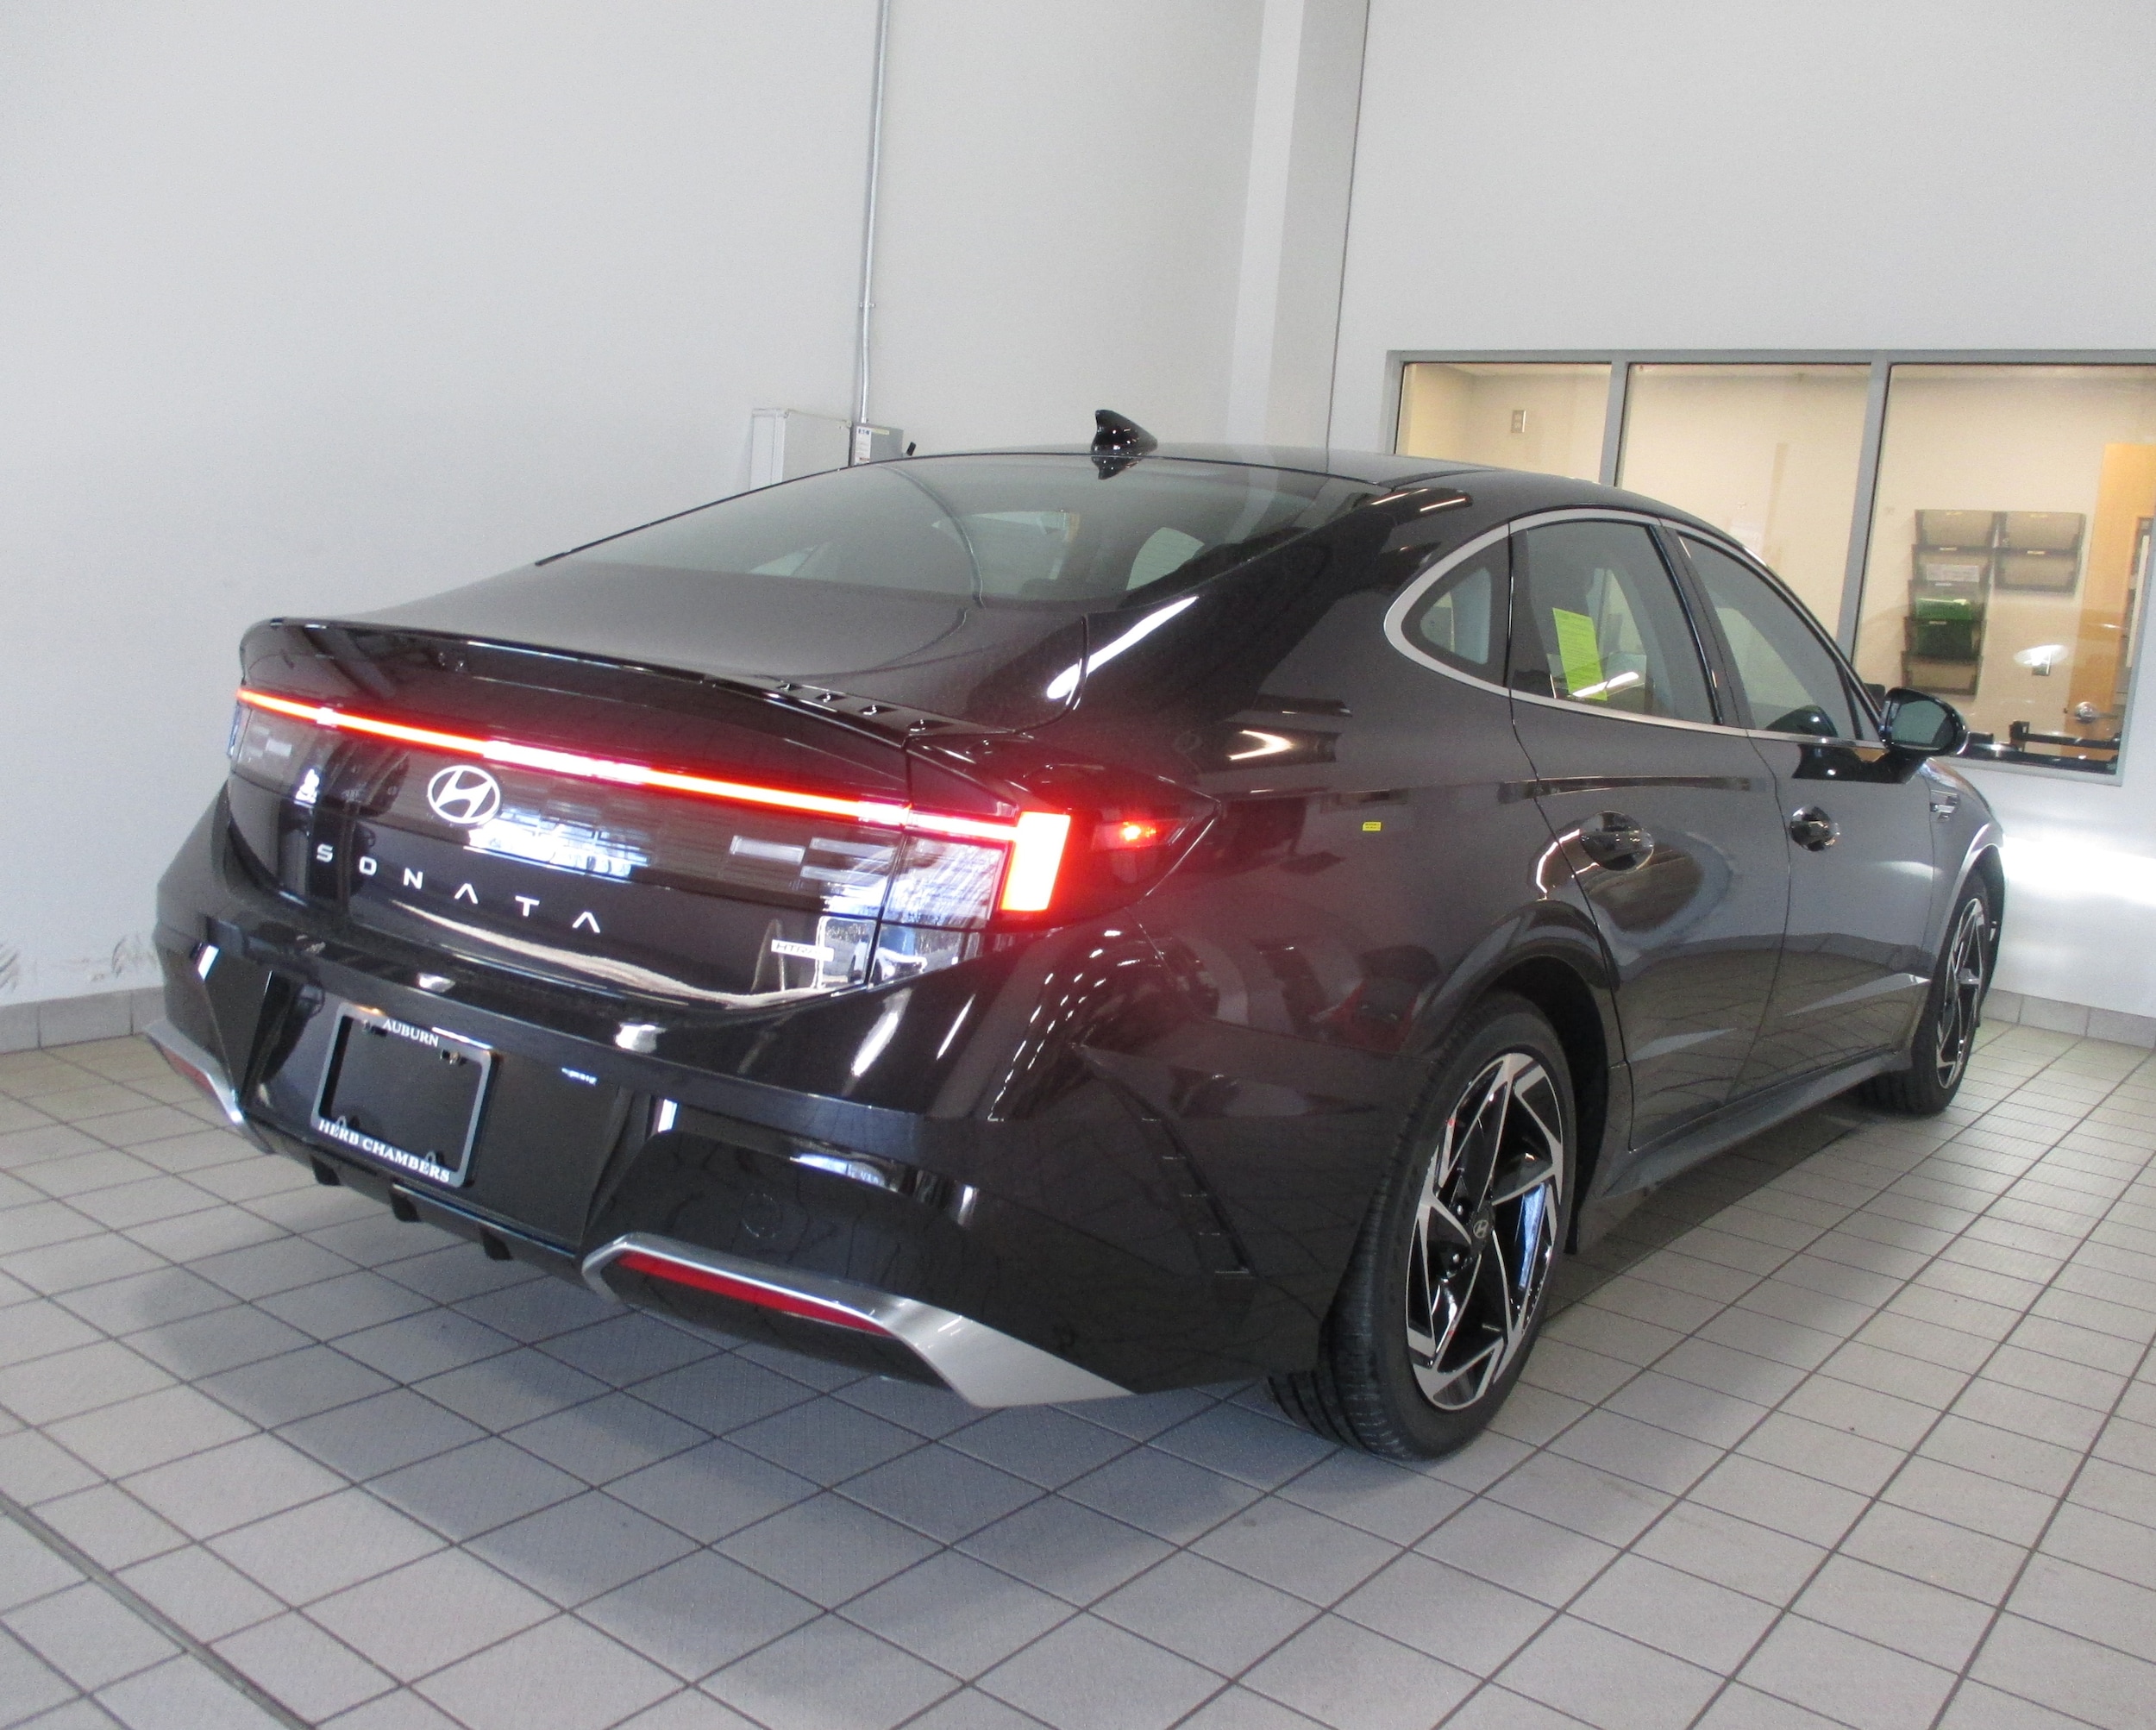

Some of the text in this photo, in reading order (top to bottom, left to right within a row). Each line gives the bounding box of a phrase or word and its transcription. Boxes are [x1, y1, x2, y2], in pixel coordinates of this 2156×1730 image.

[316, 843, 601, 934] SONATA
[381, 1018, 440, 1048] AUBURN
[317, 1119, 451, 1184] HERB CHAMBERS
